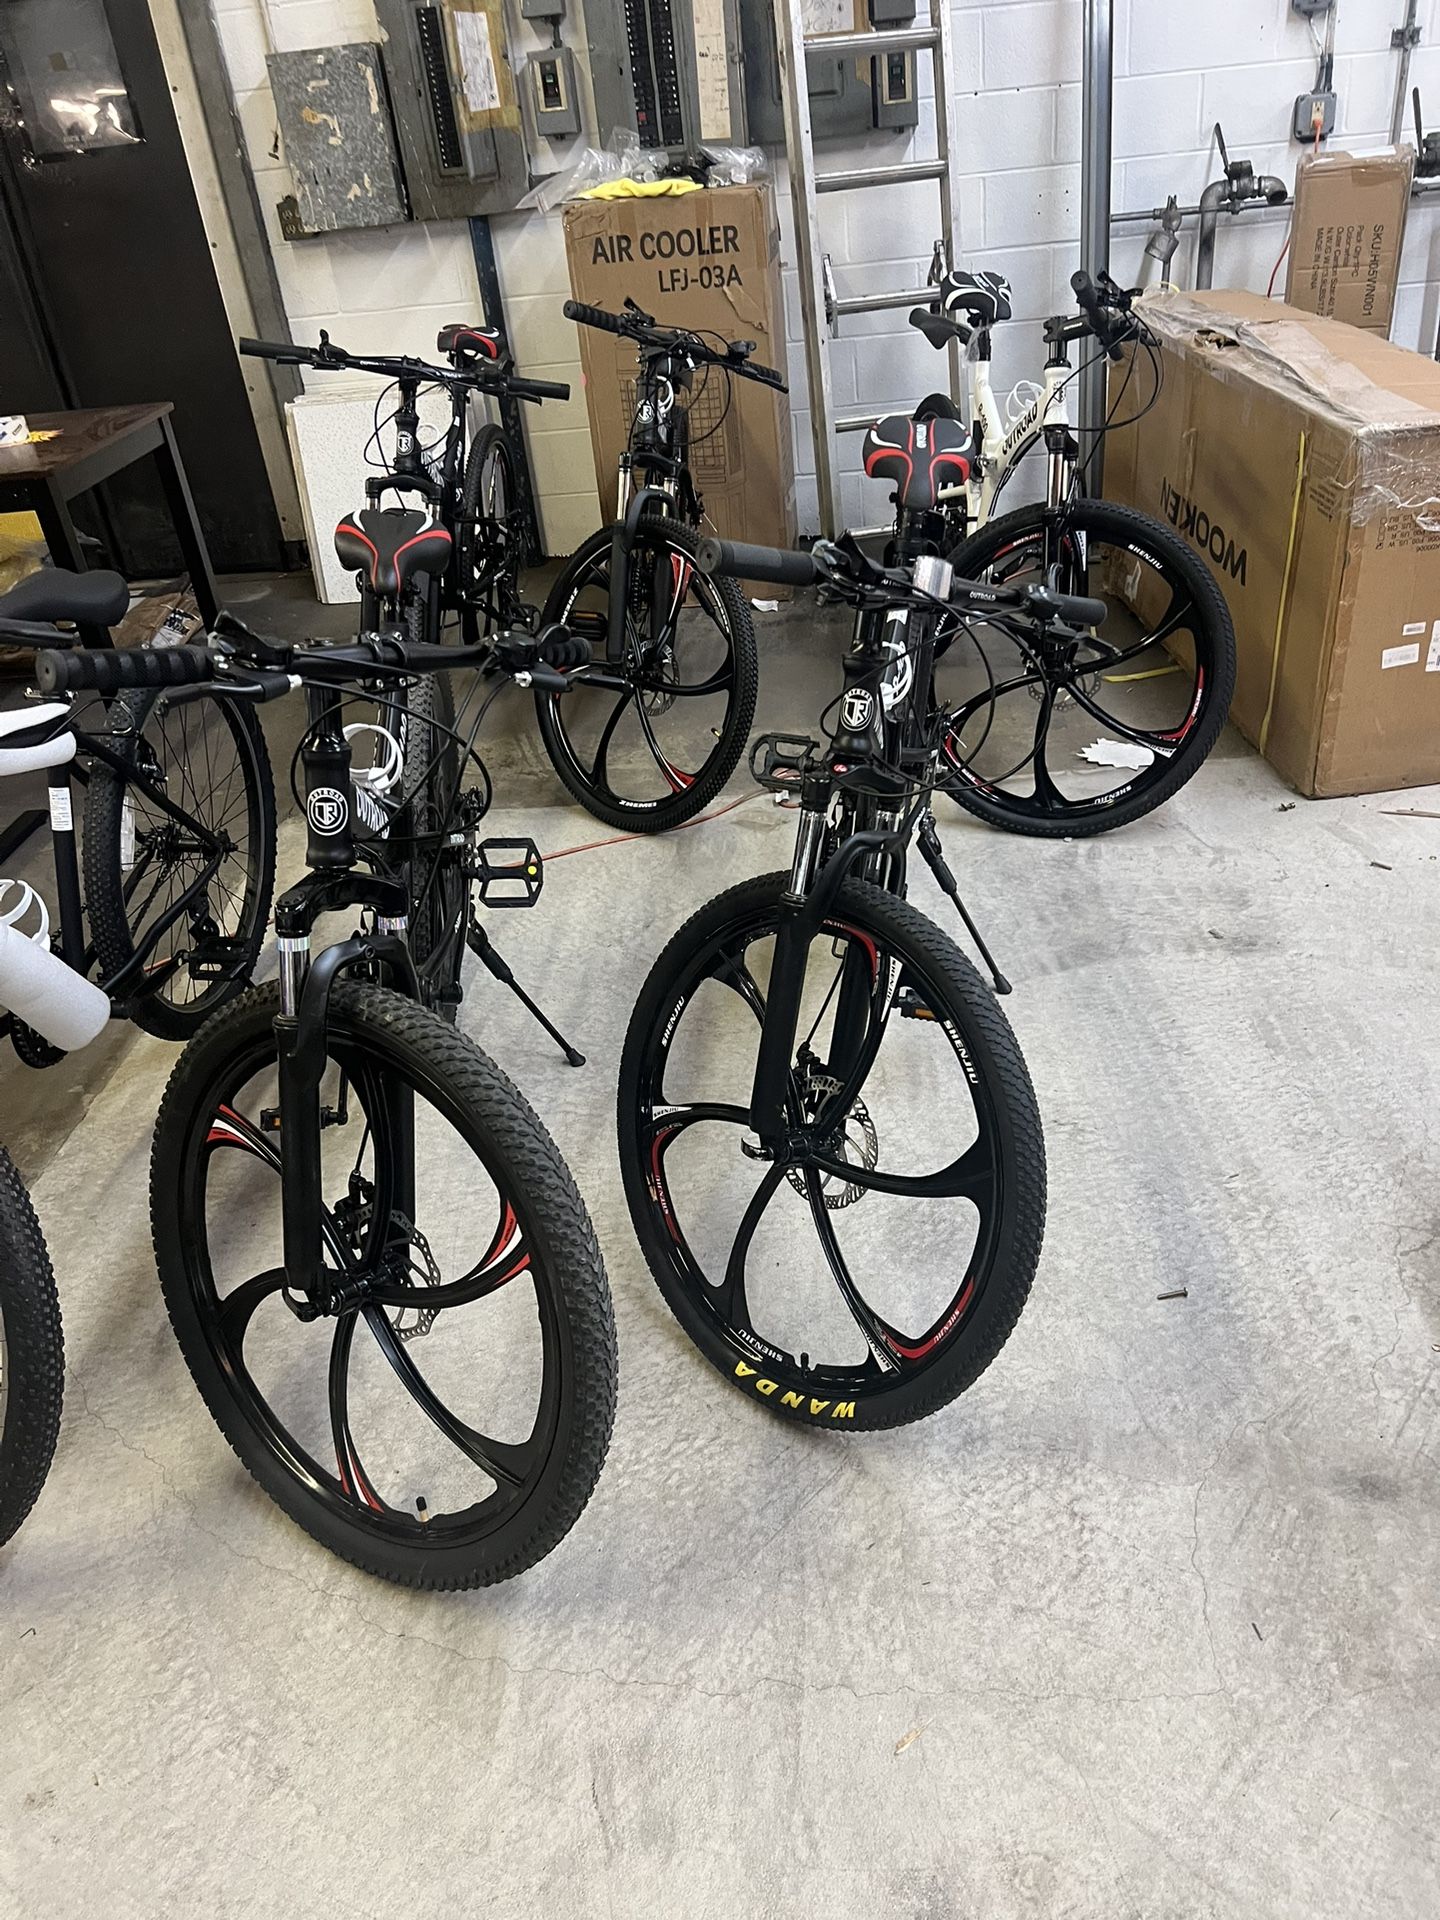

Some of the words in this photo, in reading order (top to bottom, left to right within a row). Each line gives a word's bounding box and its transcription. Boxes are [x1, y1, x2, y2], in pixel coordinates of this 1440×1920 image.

[592, 234, 634, 264] AIR
[640, 225, 740, 261] COOLER
[658, 264, 742, 292] LFJ-03A
[1362, 224, 1384, 316] SKU:H05WN001
[1160, 477, 1247, 587] WOOKEN
[1128, 544, 1163, 570] SHENJIU
[1094, 785, 1132, 805] SHENJIU
[886, 957, 898, 1003] SHENJIU
[661, 996, 685, 1048] SHENJIU
[943, 1019, 980, 1085] SHENJIU
[653, 1106, 680, 1119] SHENJIU
[655, 1174, 670, 1217] SHENJIU
[738, 1328, 784, 1362] SHENJIU
[933, 1309, 960, 1344] SHENJIU
[734, 1360, 856, 1418] WANDA
